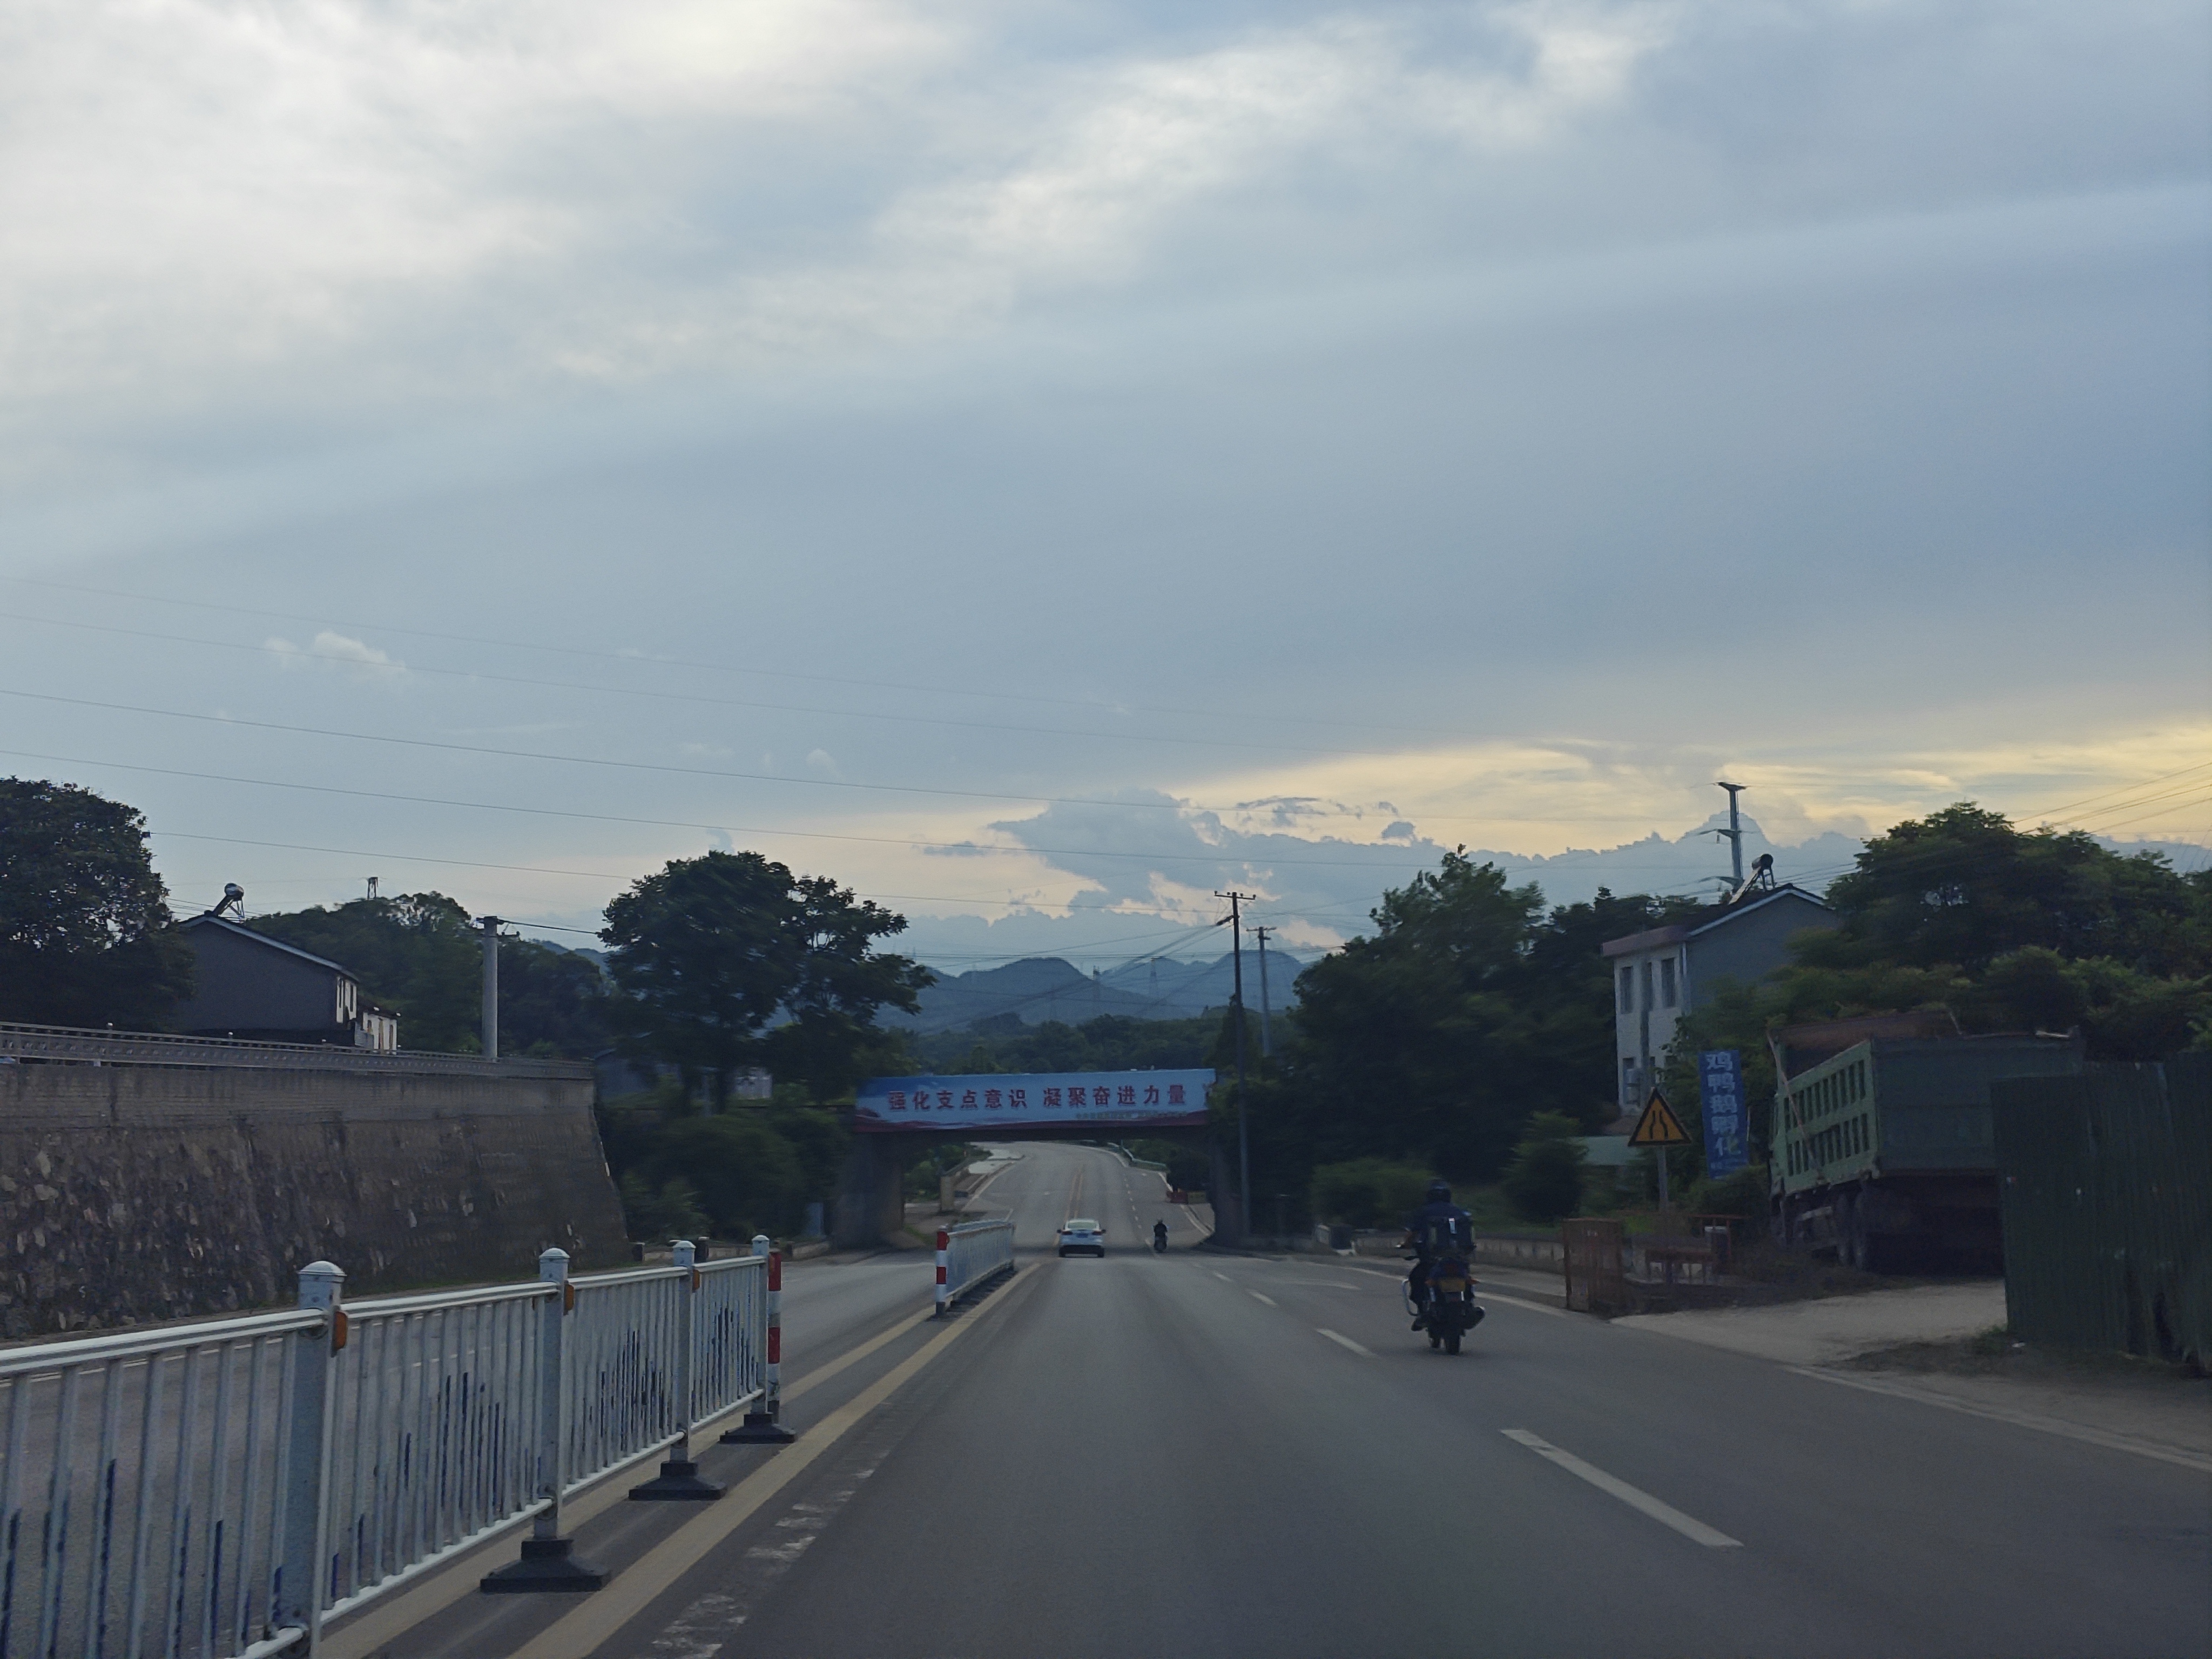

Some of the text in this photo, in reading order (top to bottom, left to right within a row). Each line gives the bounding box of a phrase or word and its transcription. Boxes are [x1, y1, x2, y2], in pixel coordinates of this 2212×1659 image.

[888, 1084, 1185, 1110] 强化支点意识 凝聚奋进力量
